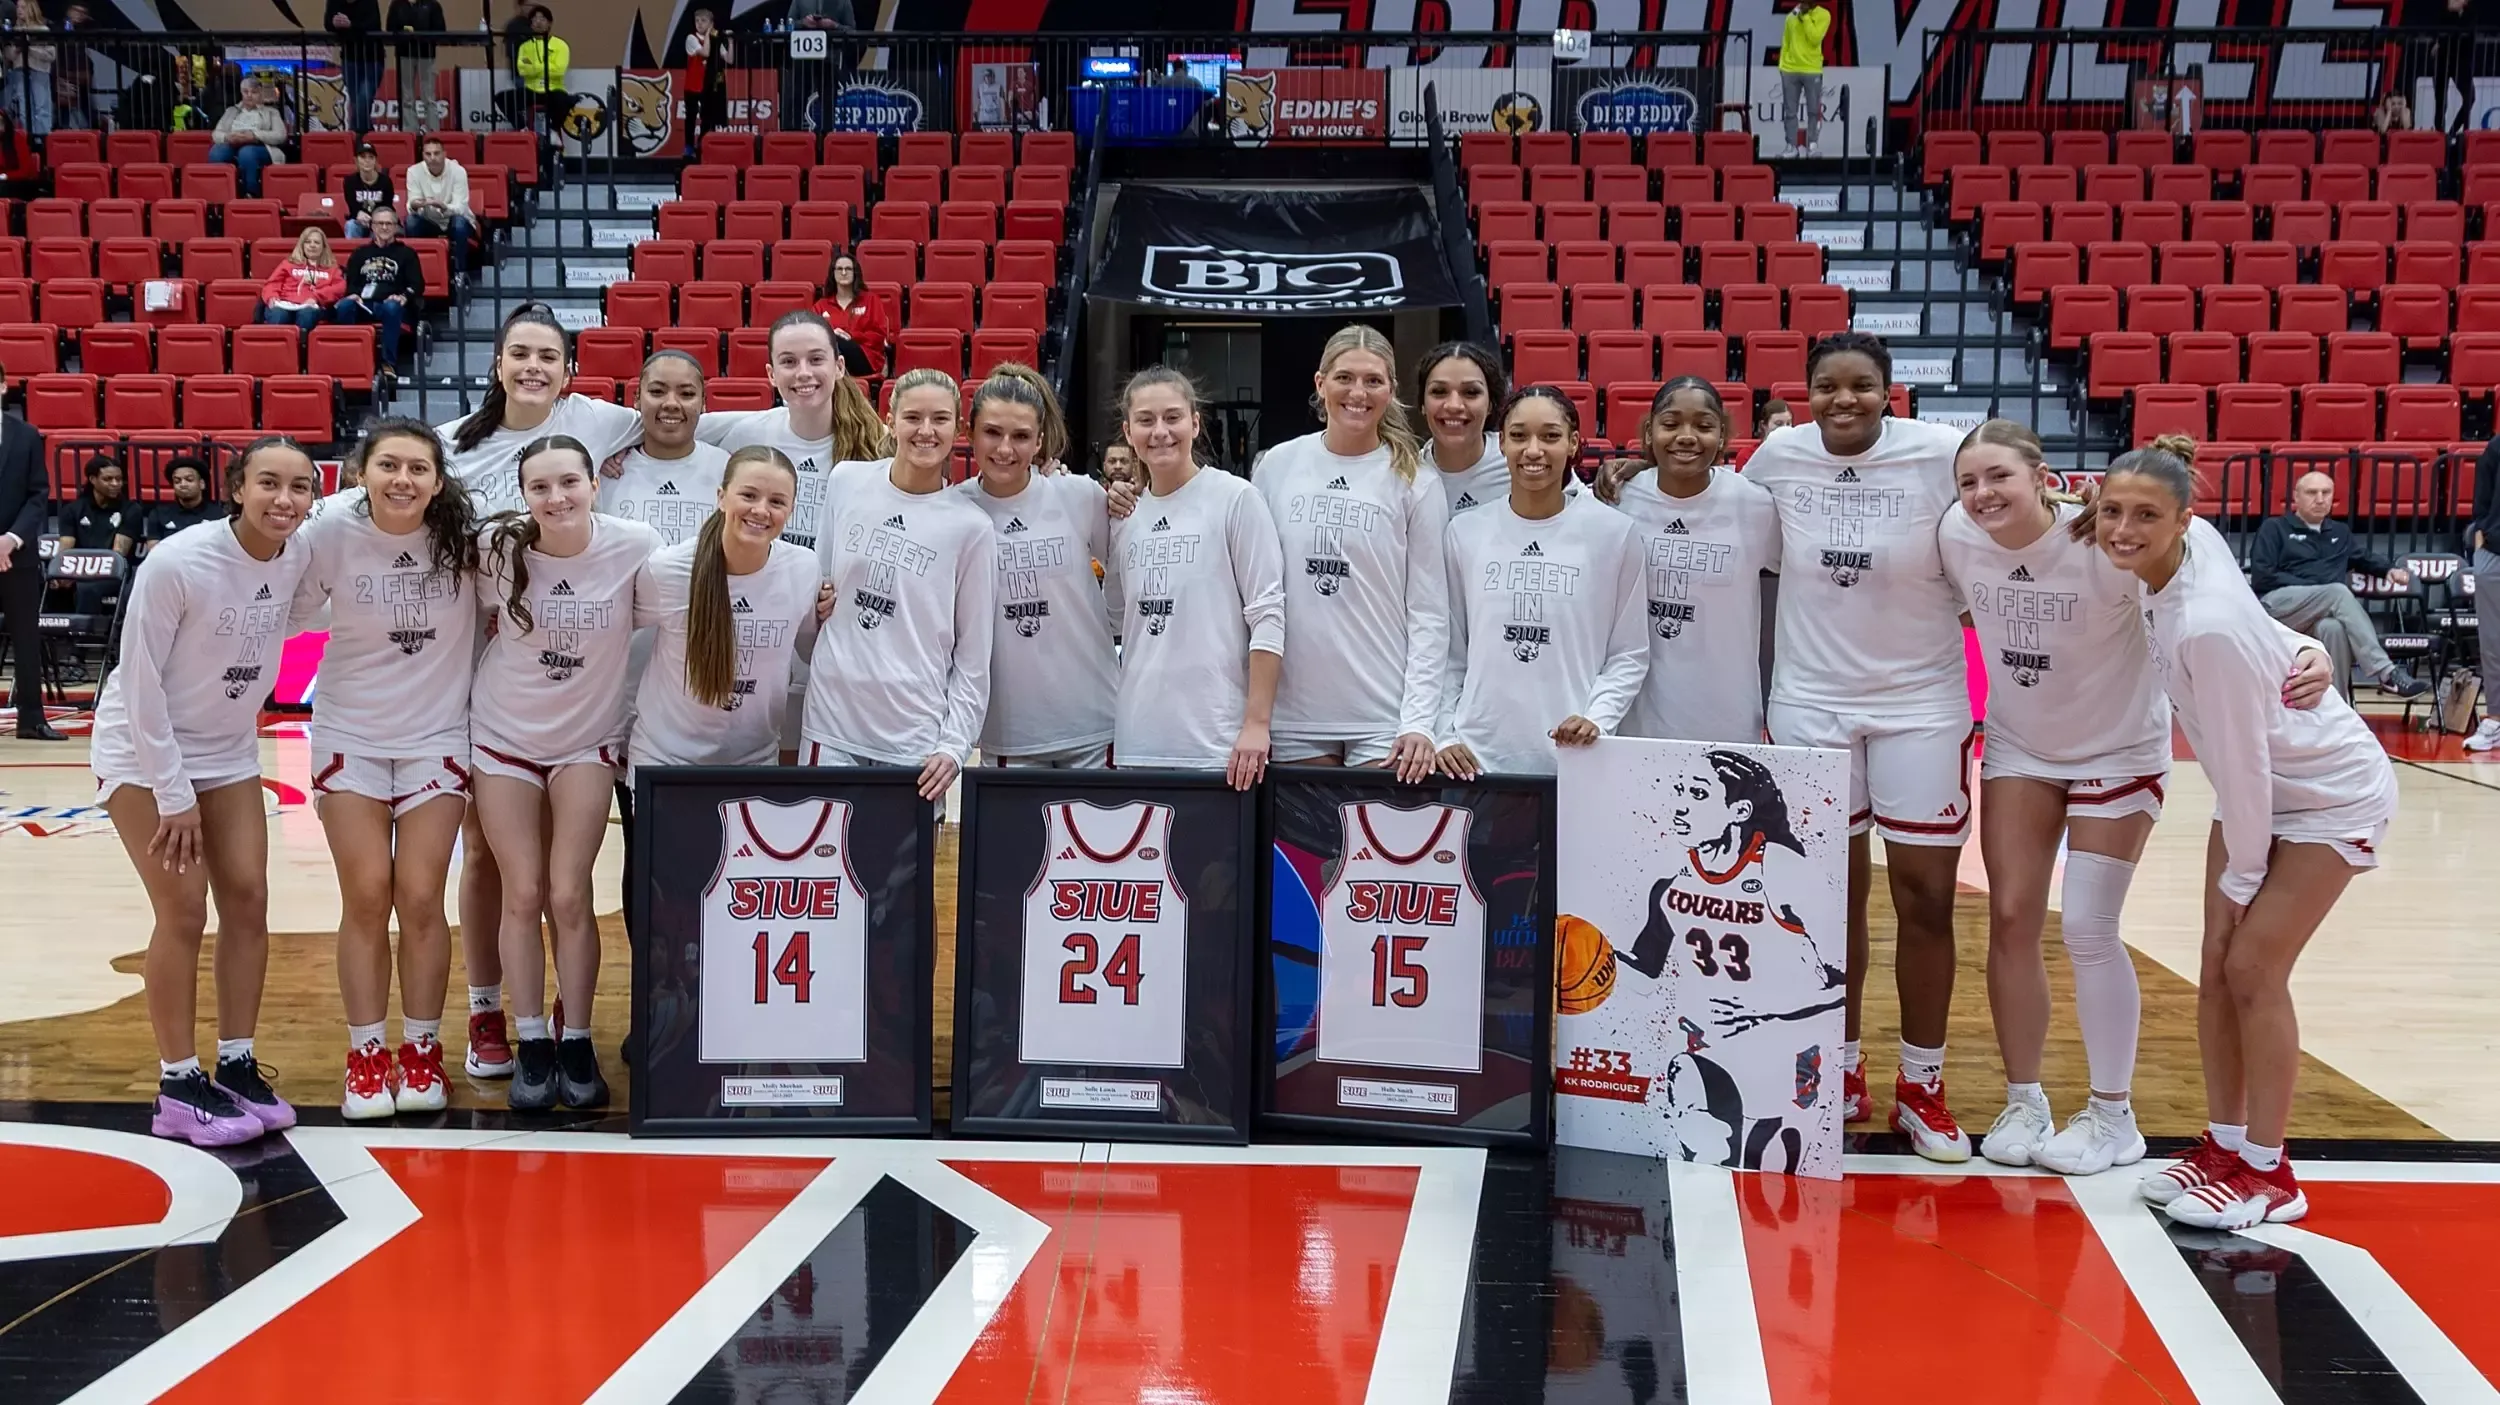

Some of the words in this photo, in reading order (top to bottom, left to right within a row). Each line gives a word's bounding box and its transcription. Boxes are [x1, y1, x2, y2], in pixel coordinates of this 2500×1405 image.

[793, 38, 823, 52] 103
[1557, 37, 1587, 53] 104
[834, 106, 861, 125] EEP
[866, 106, 907, 125] EDDY
[1279, 99, 1378, 120] EDDIE'S
[1398, 110, 1446, 123] Glol
[1449, 110, 1490, 123] Brew
[1639, 104, 1683, 124] EDDY
[1290, 125, 1314, 136] TAP
[1318, 125, 1364, 137] HOUSE
[291, 268, 329, 279] COUARS
[608, 273, 627, 281] ARE
[1175, 259, 1366, 295] BJC
[1136, 294, 1406, 312] HealthCare
[582, 315, 600, 324] ARE
[1883, 319, 1920, 329] ARENA
[1914, 366, 1952, 376] ARENA
[480, 473, 497, 501] 2
[797, 475, 828, 507] EE
[619, 499, 635, 520] 2
[643, 499, 714, 527] FEET
[1288, 494, 1306, 523] 2
[1309, 494, 1381, 533] FEET
[1455, 500, 1479, 511] adidas
[1794, 485, 1813, 514] 2
[1821, 486, 1905, 518] FEET
[1003, 525, 1028, 535] adidas
[1313, 525, 1344, 557] IN
[1663, 527, 1690, 535] adidas
[1829, 517, 1864, 548] IN
[39, 540, 60, 558] SI
[845, 523, 865, 553] 2
[865, 528, 938, 577] FEET
[997, 536, 1065, 571] FEET
[1127, 542, 1138, 571] 2
[1139, 533, 1201, 568] FEET
[1649, 536, 1732, 574] FEET
[1820, 548, 1873, 571] SIUE
[60, 555, 114, 576] SIUE
[864, 559, 896, 594] IN
[1305, 557, 1351, 579] SIUE
[1483, 561, 1501, 591] 2
[1506, 560, 1580, 597] FEET
[2008, 573, 2035, 583] adidas
[355, 574, 373, 603] 2
[382, 571, 459, 604] FEET
[1007, 570, 1040, 600] IN
[1143, 566, 1168, 597] IN
[1656, 568, 1689, 601] IN
[540, 599, 613, 630] FEET
[853, 588, 897, 618] SIUE
[1003, 600, 1051, 620] SIUE
[1137, 598, 1175, 617] SIUE
[1513, 591, 1543, 623] IN
[1648, 598, 1696, 623] SIUE
[1972, 581, 1990, 613] 2
[1996, 586, 2078, 622] FEET
[38, 618, 70, 627] OUGARS
[215, 607, 237, 636] 2
[240, 602, 288, 636] FEE
[393, 601, 428, 629] IN
[548, 629, 579, 655] IN
[734, 618, 789, 649] EET
[1503, 624, 1552, 645] SIUE
[2006, 619, 2040, 651] IN
[2385, 637, 2429, 648] COUGARS
[236, 635, 266, 663] IN
[736, 648, 754, 676] N
[2000, 648, 2053, 671] SIUE
[222, 664, 262, 682] SIUE
[734, 679, 758, 695] UE
[725, 876, 841, 920] SIUE
[1048, 879, 1164, 923] SIUE
[1344, 880, 1462, 927] SIUE
[1667, 887, 1765, 925] COUGARS
[1685, 926, 1752, 982] 33
[751, 930, 816, 1005] 14
[1058, 932, 1146, 1006] 24
[1370, 934, 1430, 1008] 15
[1569, 1046, 1632, 1077] #33
[727, 1085, 753, 1096] SIUE
[812, 1084, 838, 1095] SIUE
[1045, 1087, 1071, 1098] SIUE
[1130, 1090, 1155, 1101] SIUE
[1342, 1085, 1368, 1097] SIUE
[1427, 1092, 1453, 1104] SIUE
[1564, 1076, 1578, 1087] KK
[1580, 1078, 1640, 1094] RODRIGUEZ
